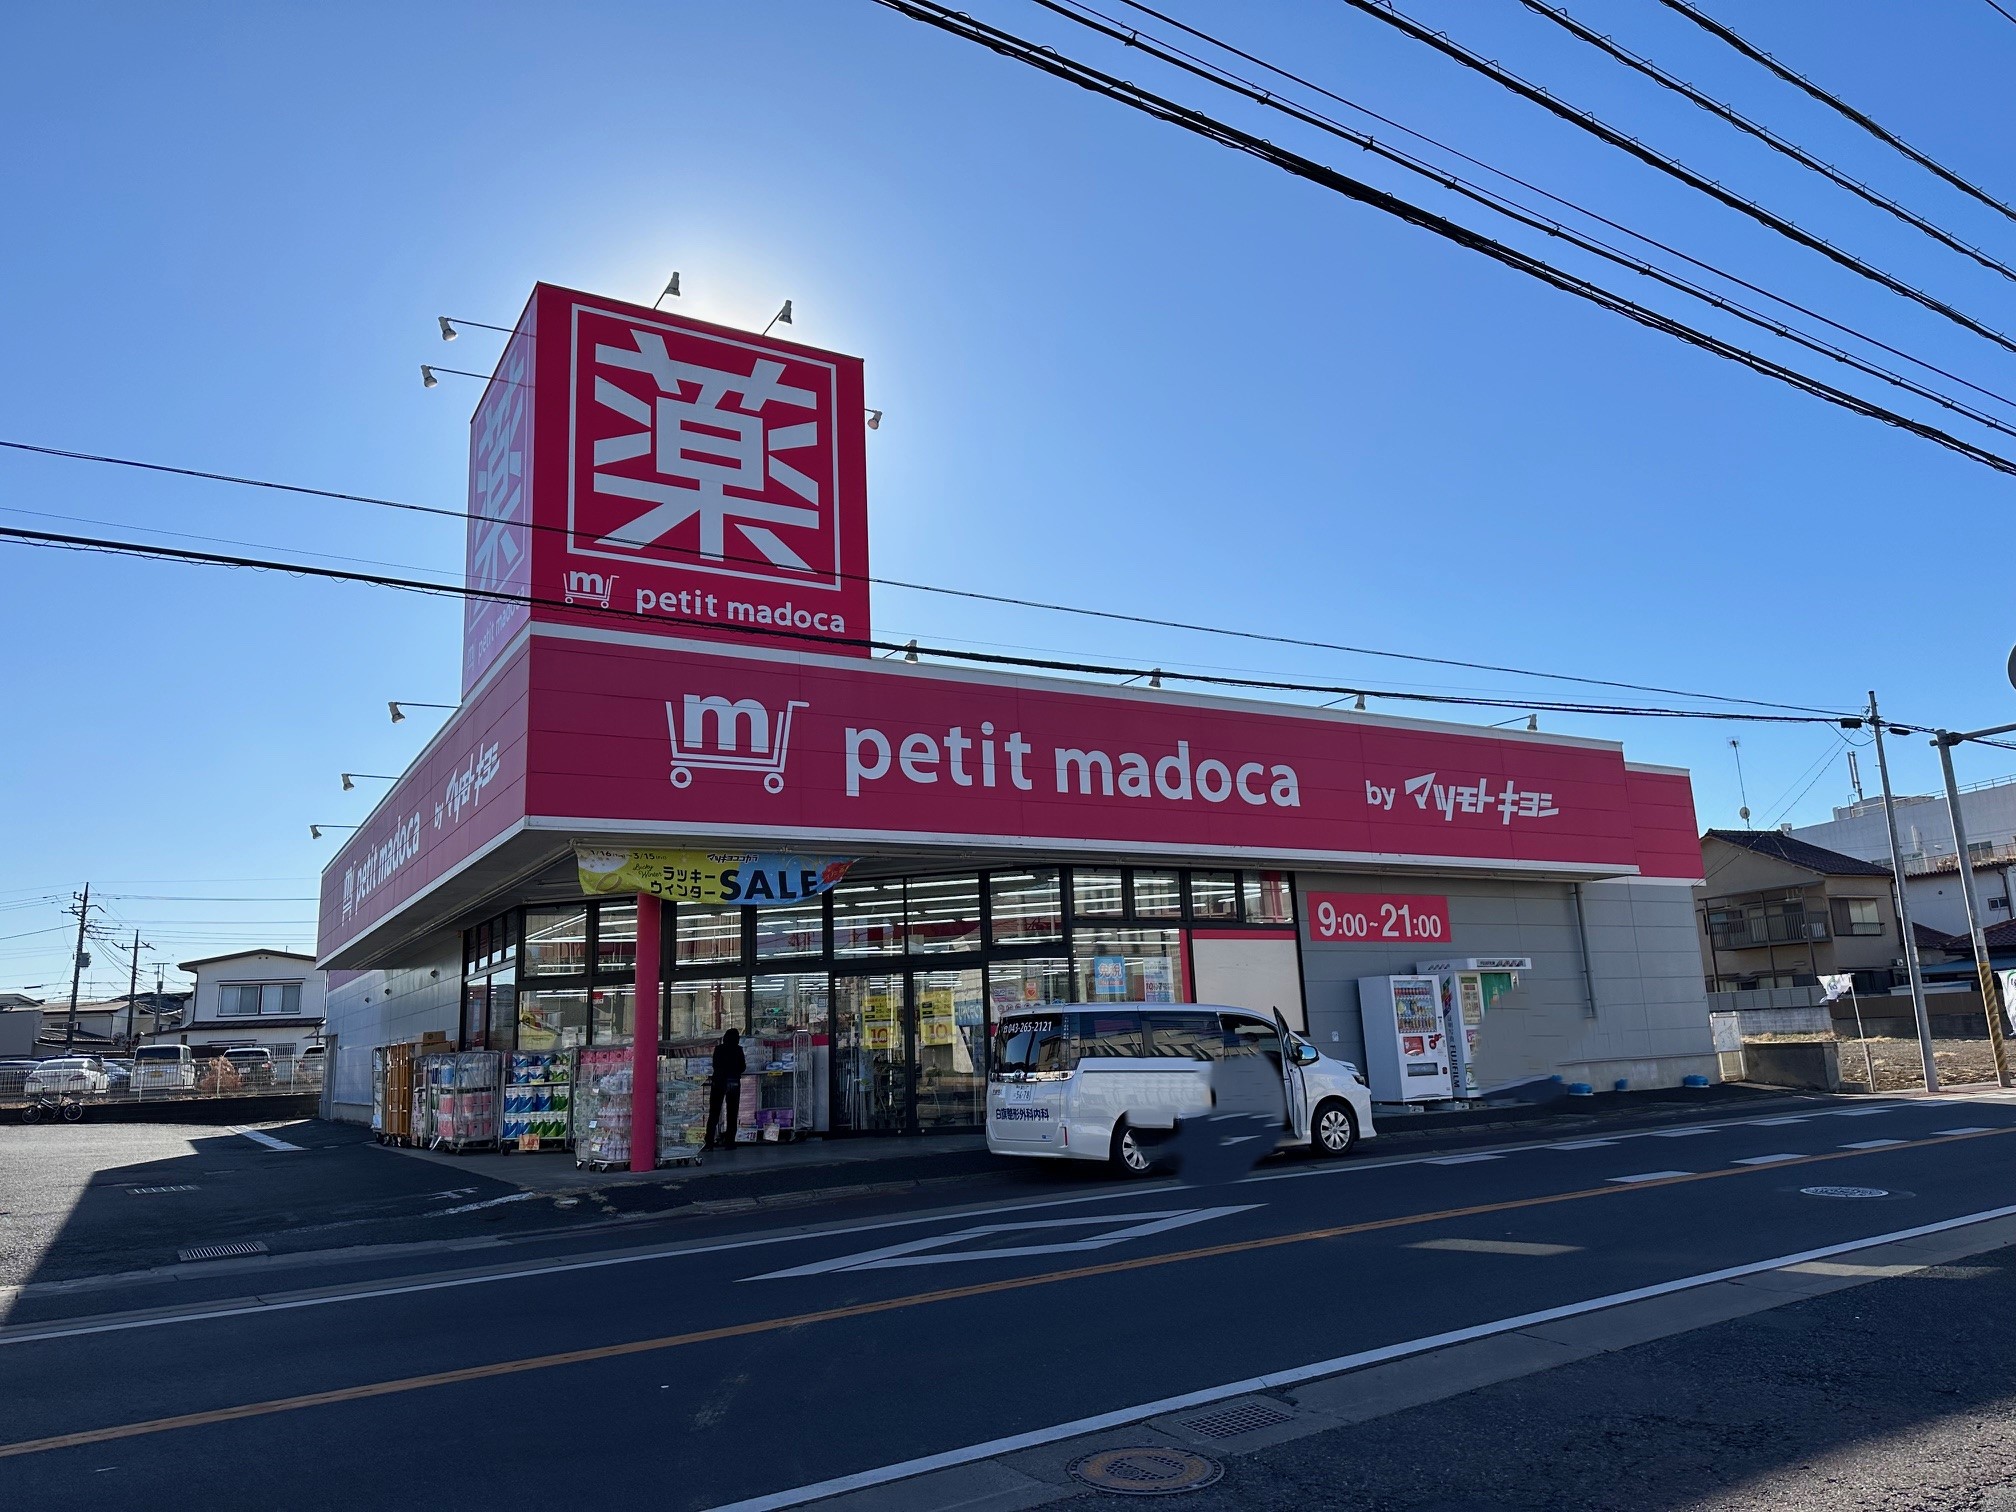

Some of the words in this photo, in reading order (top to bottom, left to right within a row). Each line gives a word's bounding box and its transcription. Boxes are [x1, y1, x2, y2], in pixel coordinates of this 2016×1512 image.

[593, 328, 820, 574] 薬
[636, 588, 718, 615] petit
[727, 598, 846, 634] madoca
[845, 720, 1033, 797] petit
[1054, 739, 1302, 808] madoca
[1365, 779, 1396, 811] by
[1404, 771, 1560, 826] マツモトキヨシ
[354, 842, 378, 915] petit
[378, 811, 420, 884] madoca
[662, 866, 716, 883] ラッキー
[706, 853, 760, 864] マツキヨココカラ
[650, 880, 716, 899] ウィンター
[719, 868, 818, 901] SALE
[1449, 1044, 1460, 1088] FUJIFILM
